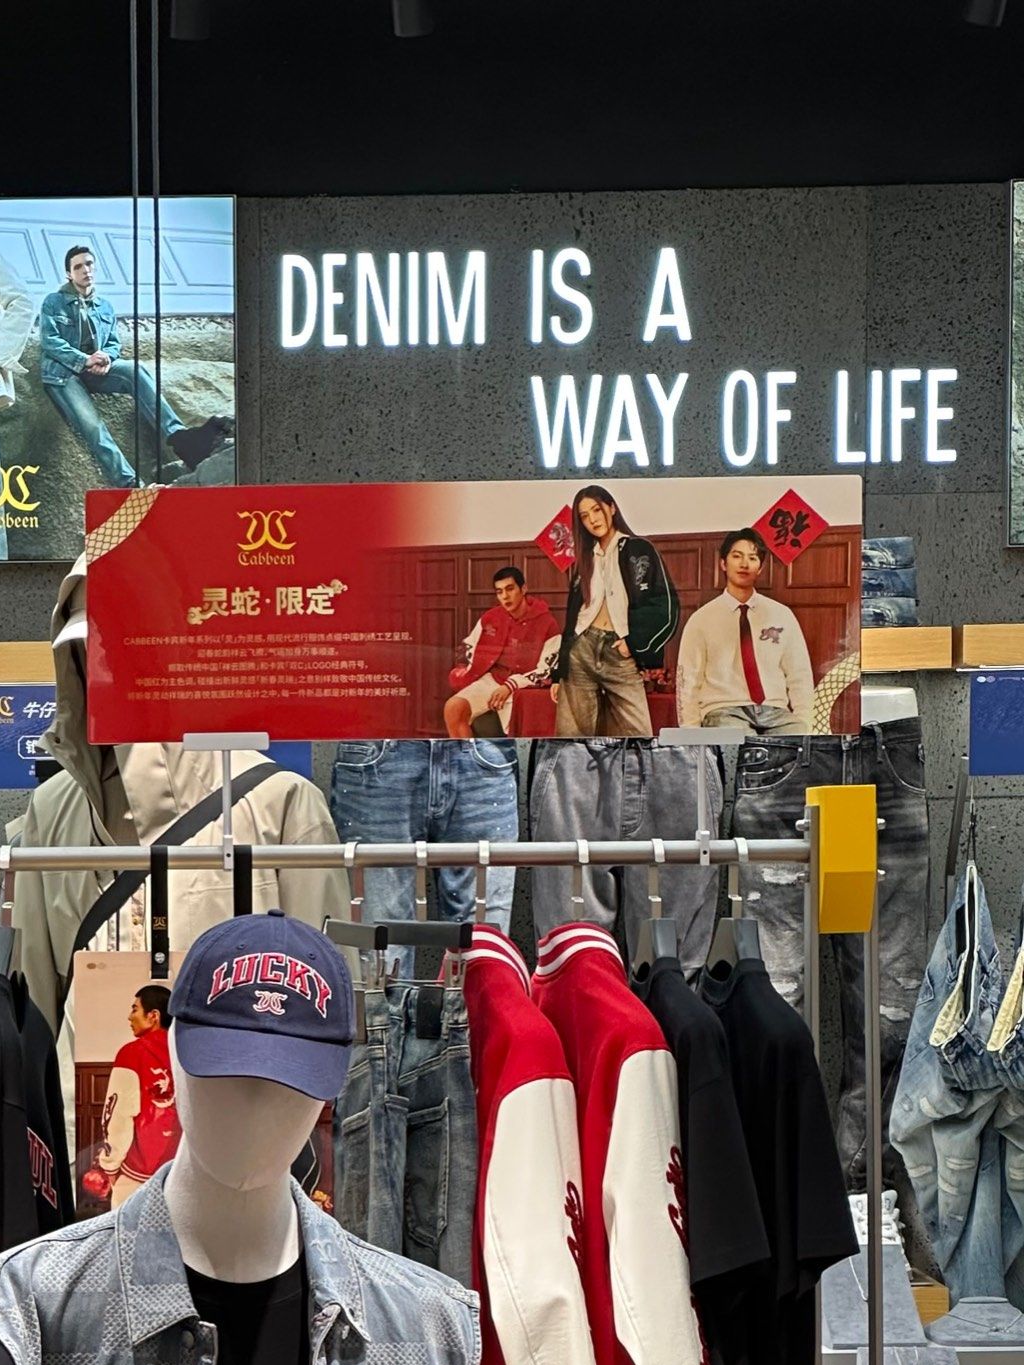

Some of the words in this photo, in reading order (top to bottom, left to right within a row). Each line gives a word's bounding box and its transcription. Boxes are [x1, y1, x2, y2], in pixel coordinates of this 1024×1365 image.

[282, 250, 486, 348] DENIM
[531, 247, 594, 345] IS
[643, 247, 692, 342] A
[530, 372, 690, 468] WAY
[722, 369, 797, 466] OF
[836, 368, 958, 463] LIFE
[238, 551, 295, 566] Cabbeen
[207, 952, 332, 1018] LUCKY
